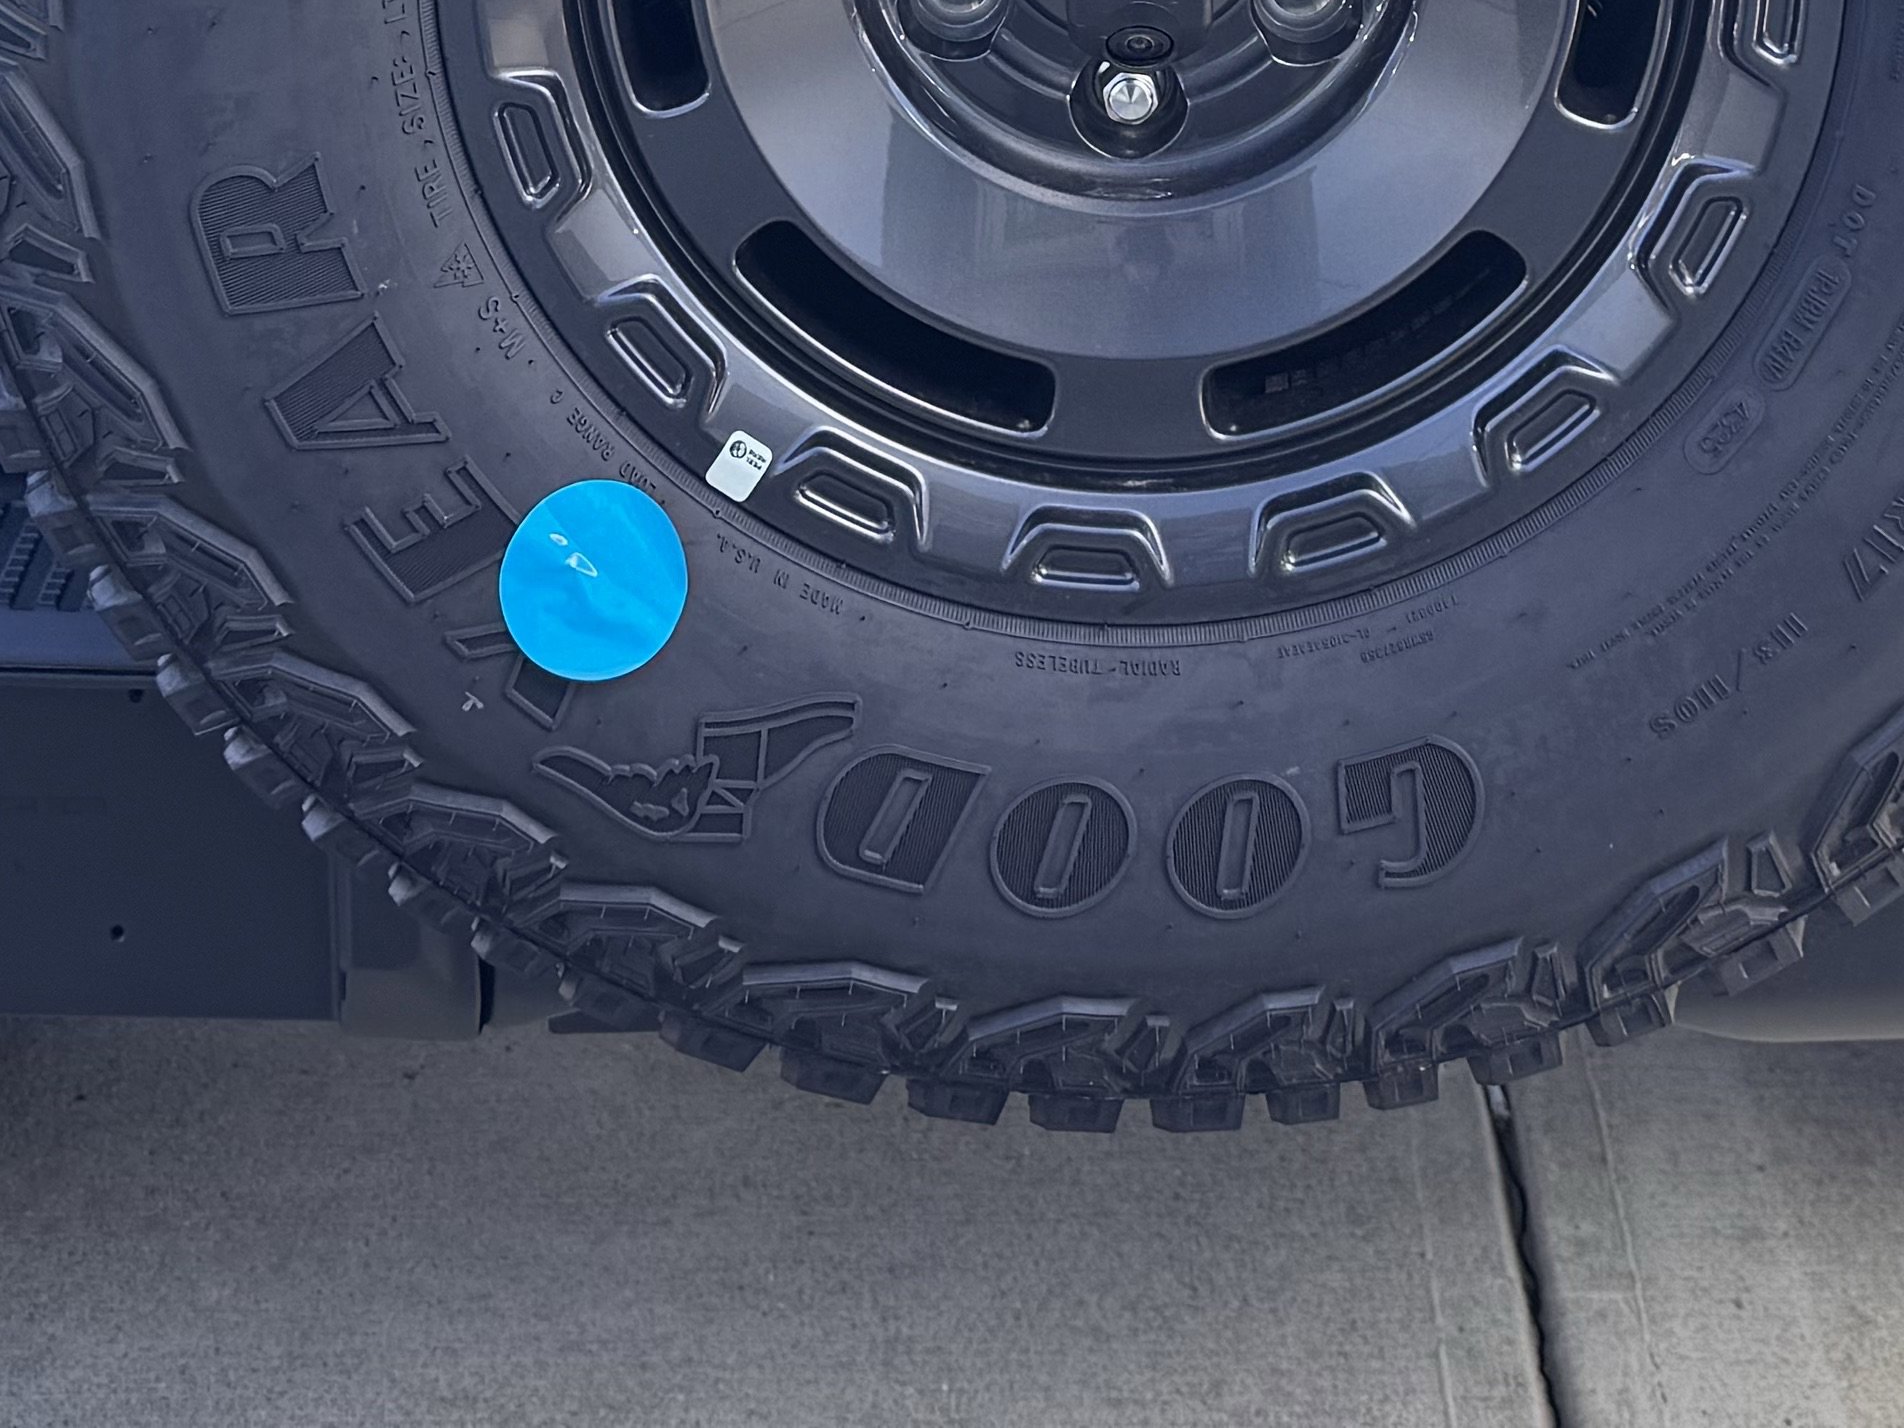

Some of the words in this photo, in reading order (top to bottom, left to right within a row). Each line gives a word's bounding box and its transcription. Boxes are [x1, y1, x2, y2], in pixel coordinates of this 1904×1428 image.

[413, 153, 455, 230] TIRE
[1826, 181, 1879, 256] DOT
[476, 295, 526, 364] M+S
[565, 406, 616, 464] RANGE
[773, 570, 791, 590] IN
[799, 581, 846, 616] MADE
[1011, 648, 1101, 676] TUBELESS
[1118, 656, 1181, 677] RADIAL
